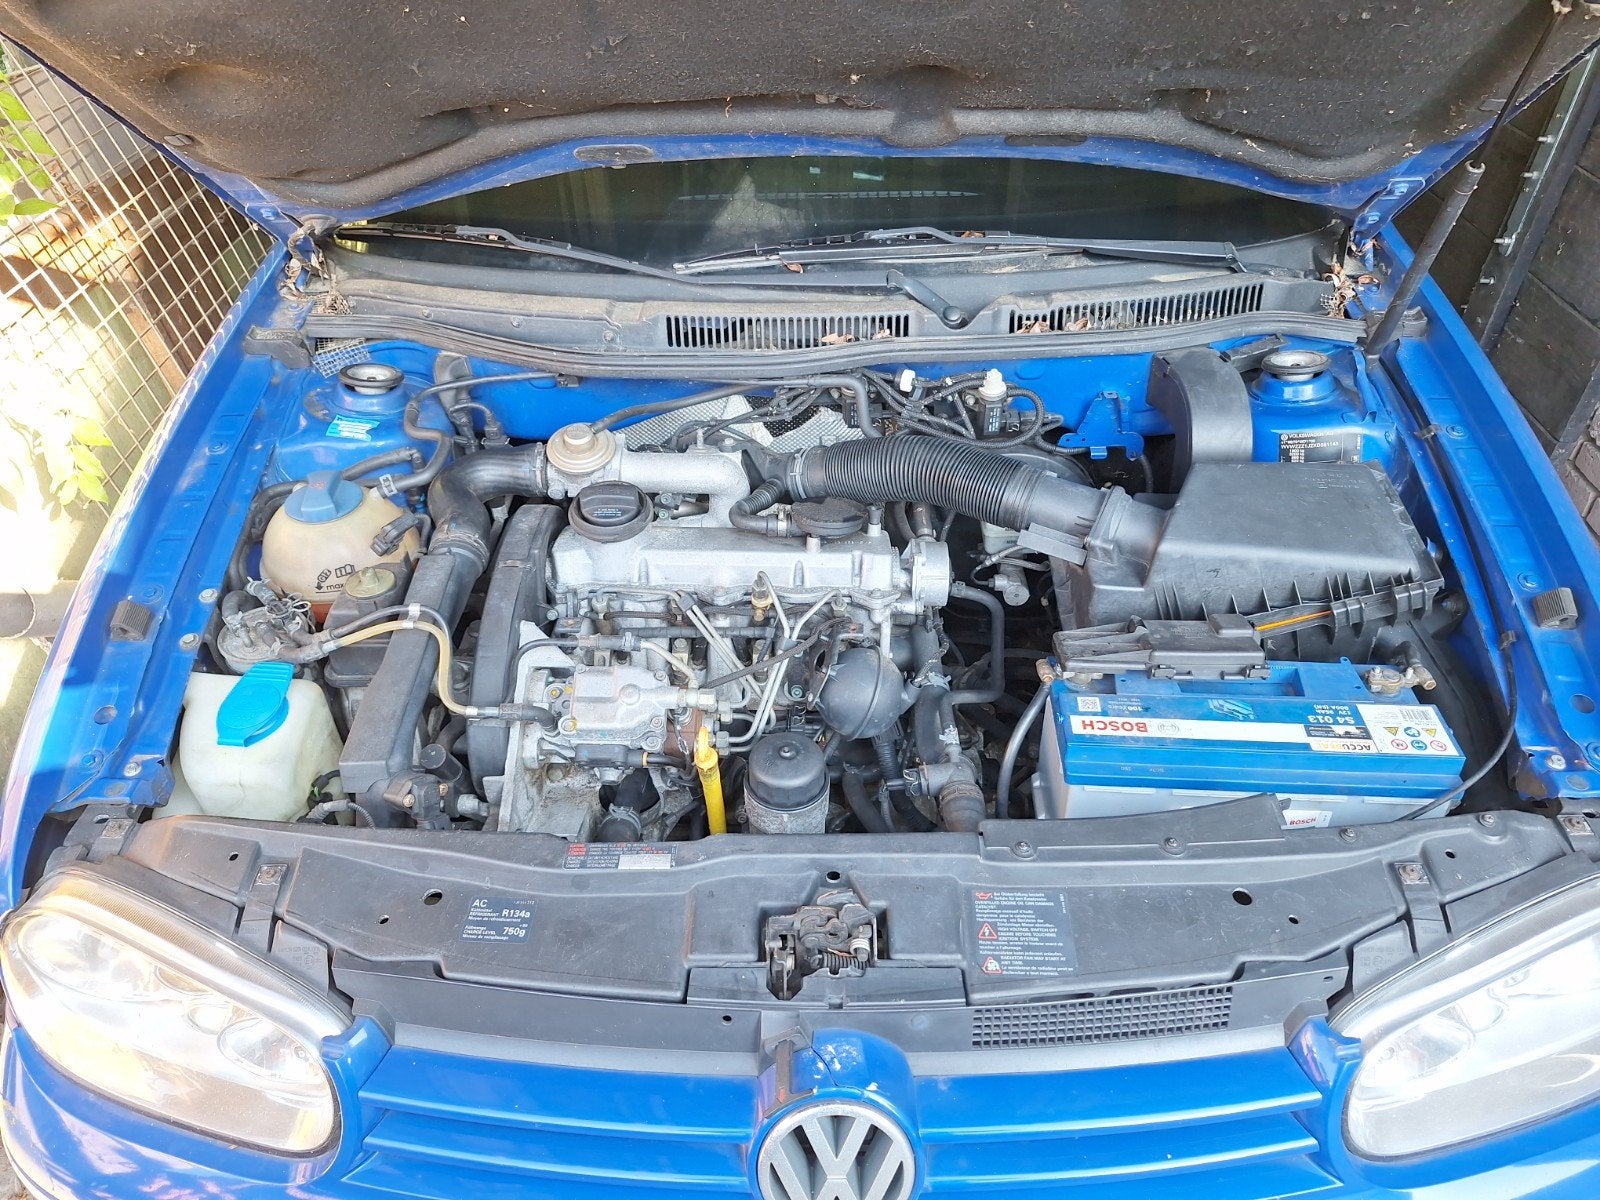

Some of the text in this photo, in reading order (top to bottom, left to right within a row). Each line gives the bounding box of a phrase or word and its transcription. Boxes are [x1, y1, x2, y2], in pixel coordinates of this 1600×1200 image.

[1308, 715, 1355, 724] S4 013
[1081, 720, 1148, 732] BOSCH
[1290, 817, 1317, 825] BOSCH
[472, 899, 488, 907] AC
[502, 909, 530, 918] R134a
[502, 927, 525, 937] 750g
